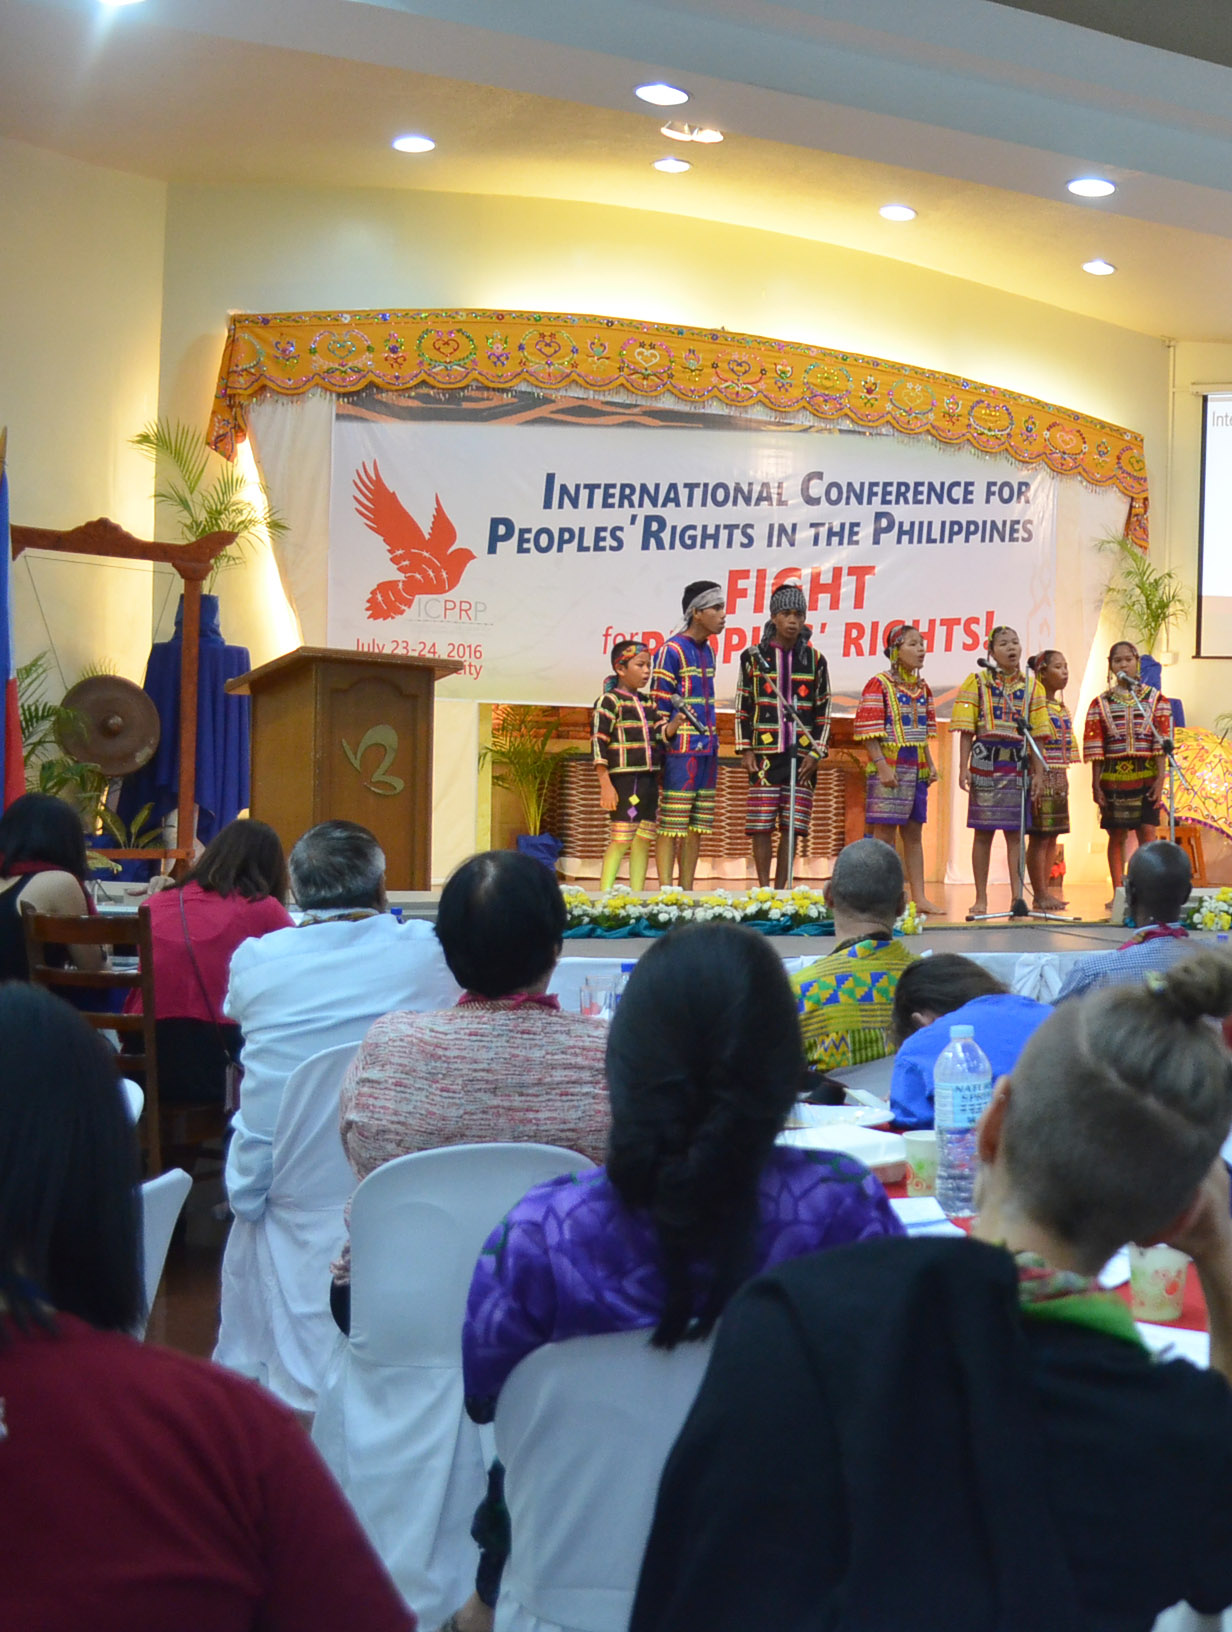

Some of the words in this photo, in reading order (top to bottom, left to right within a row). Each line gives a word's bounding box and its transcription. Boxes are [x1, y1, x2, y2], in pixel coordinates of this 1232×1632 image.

[542, 472, 790, 510] INTERNATIONAL
[800, 471, 975, 506] CONFERENCE
[984, 481, 1031, 505] FOR
[766, 522, 797, 548] IN
[809, 521, 861, 547] THE
[872, 511, 1034, 546] PHILIPPINES
[417, 598, 488, 621] ICPRP
[447, 642, 483, 660] 2016
[455, 659, 483, 680] ity
